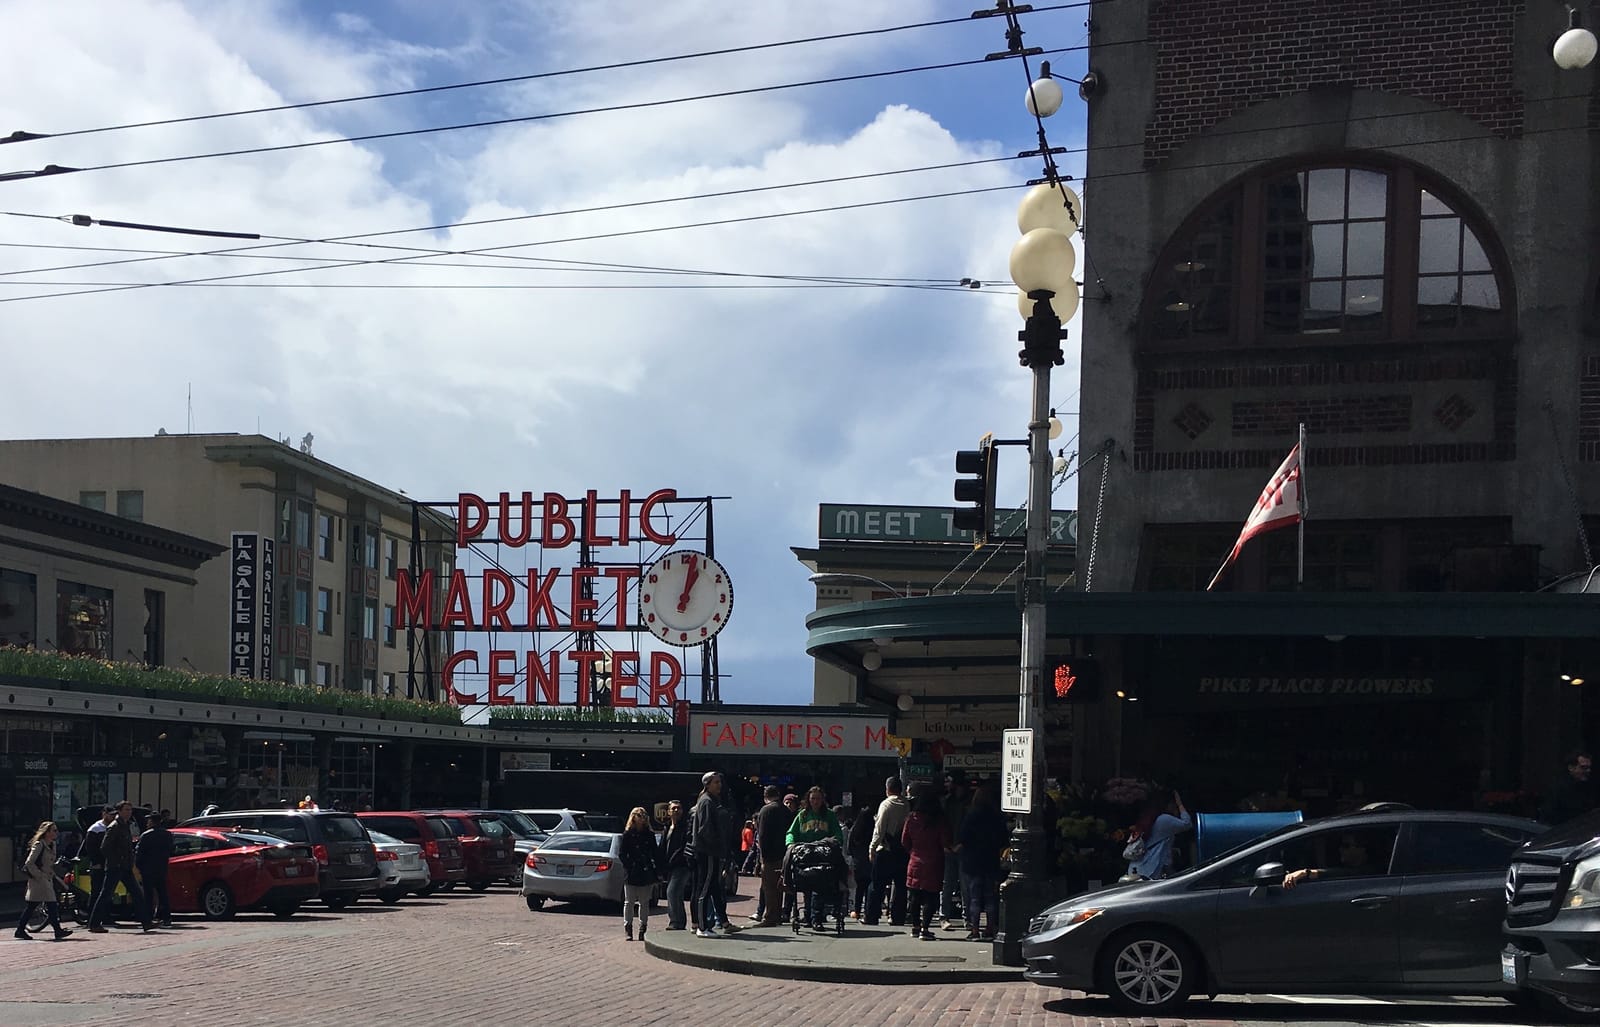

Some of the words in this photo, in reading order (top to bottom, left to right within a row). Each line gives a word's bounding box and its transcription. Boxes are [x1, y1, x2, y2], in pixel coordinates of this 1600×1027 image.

[457, 488, 677, 548] PUBLIC
[836, 510, 921, 536] MEET
[663, 560, 670, 570] 11
[703, 560, 707, 569] 1
[649, 574, 658, 583] 10
[715, 574, 722, 583] 2
[235, 565, 253, 624] SALLE
[263, 570, 272, 628] SALLE
[395, 566, 641, 631] MARKET
[643, 594, 651, 603] 9
[719, 593, 726, 603] 3
[648, 613, 655, 623] 8
[712, 613, 721, 623] 4
[662, 627, 669, 637] 7
[680, 632, 687, 641] 6
[700, 627, 707, 637] 5
[441, 649, 682, 707] CENTER
[1199, 677, 1251, 694] PIKE
[1256, 677, 1325, 694] PLACE
[1329, 677, 1434, 694] FLOWERS
[702, 721, 844, 749] FARMERS
[1010, 749, 1025, 758] WALK
